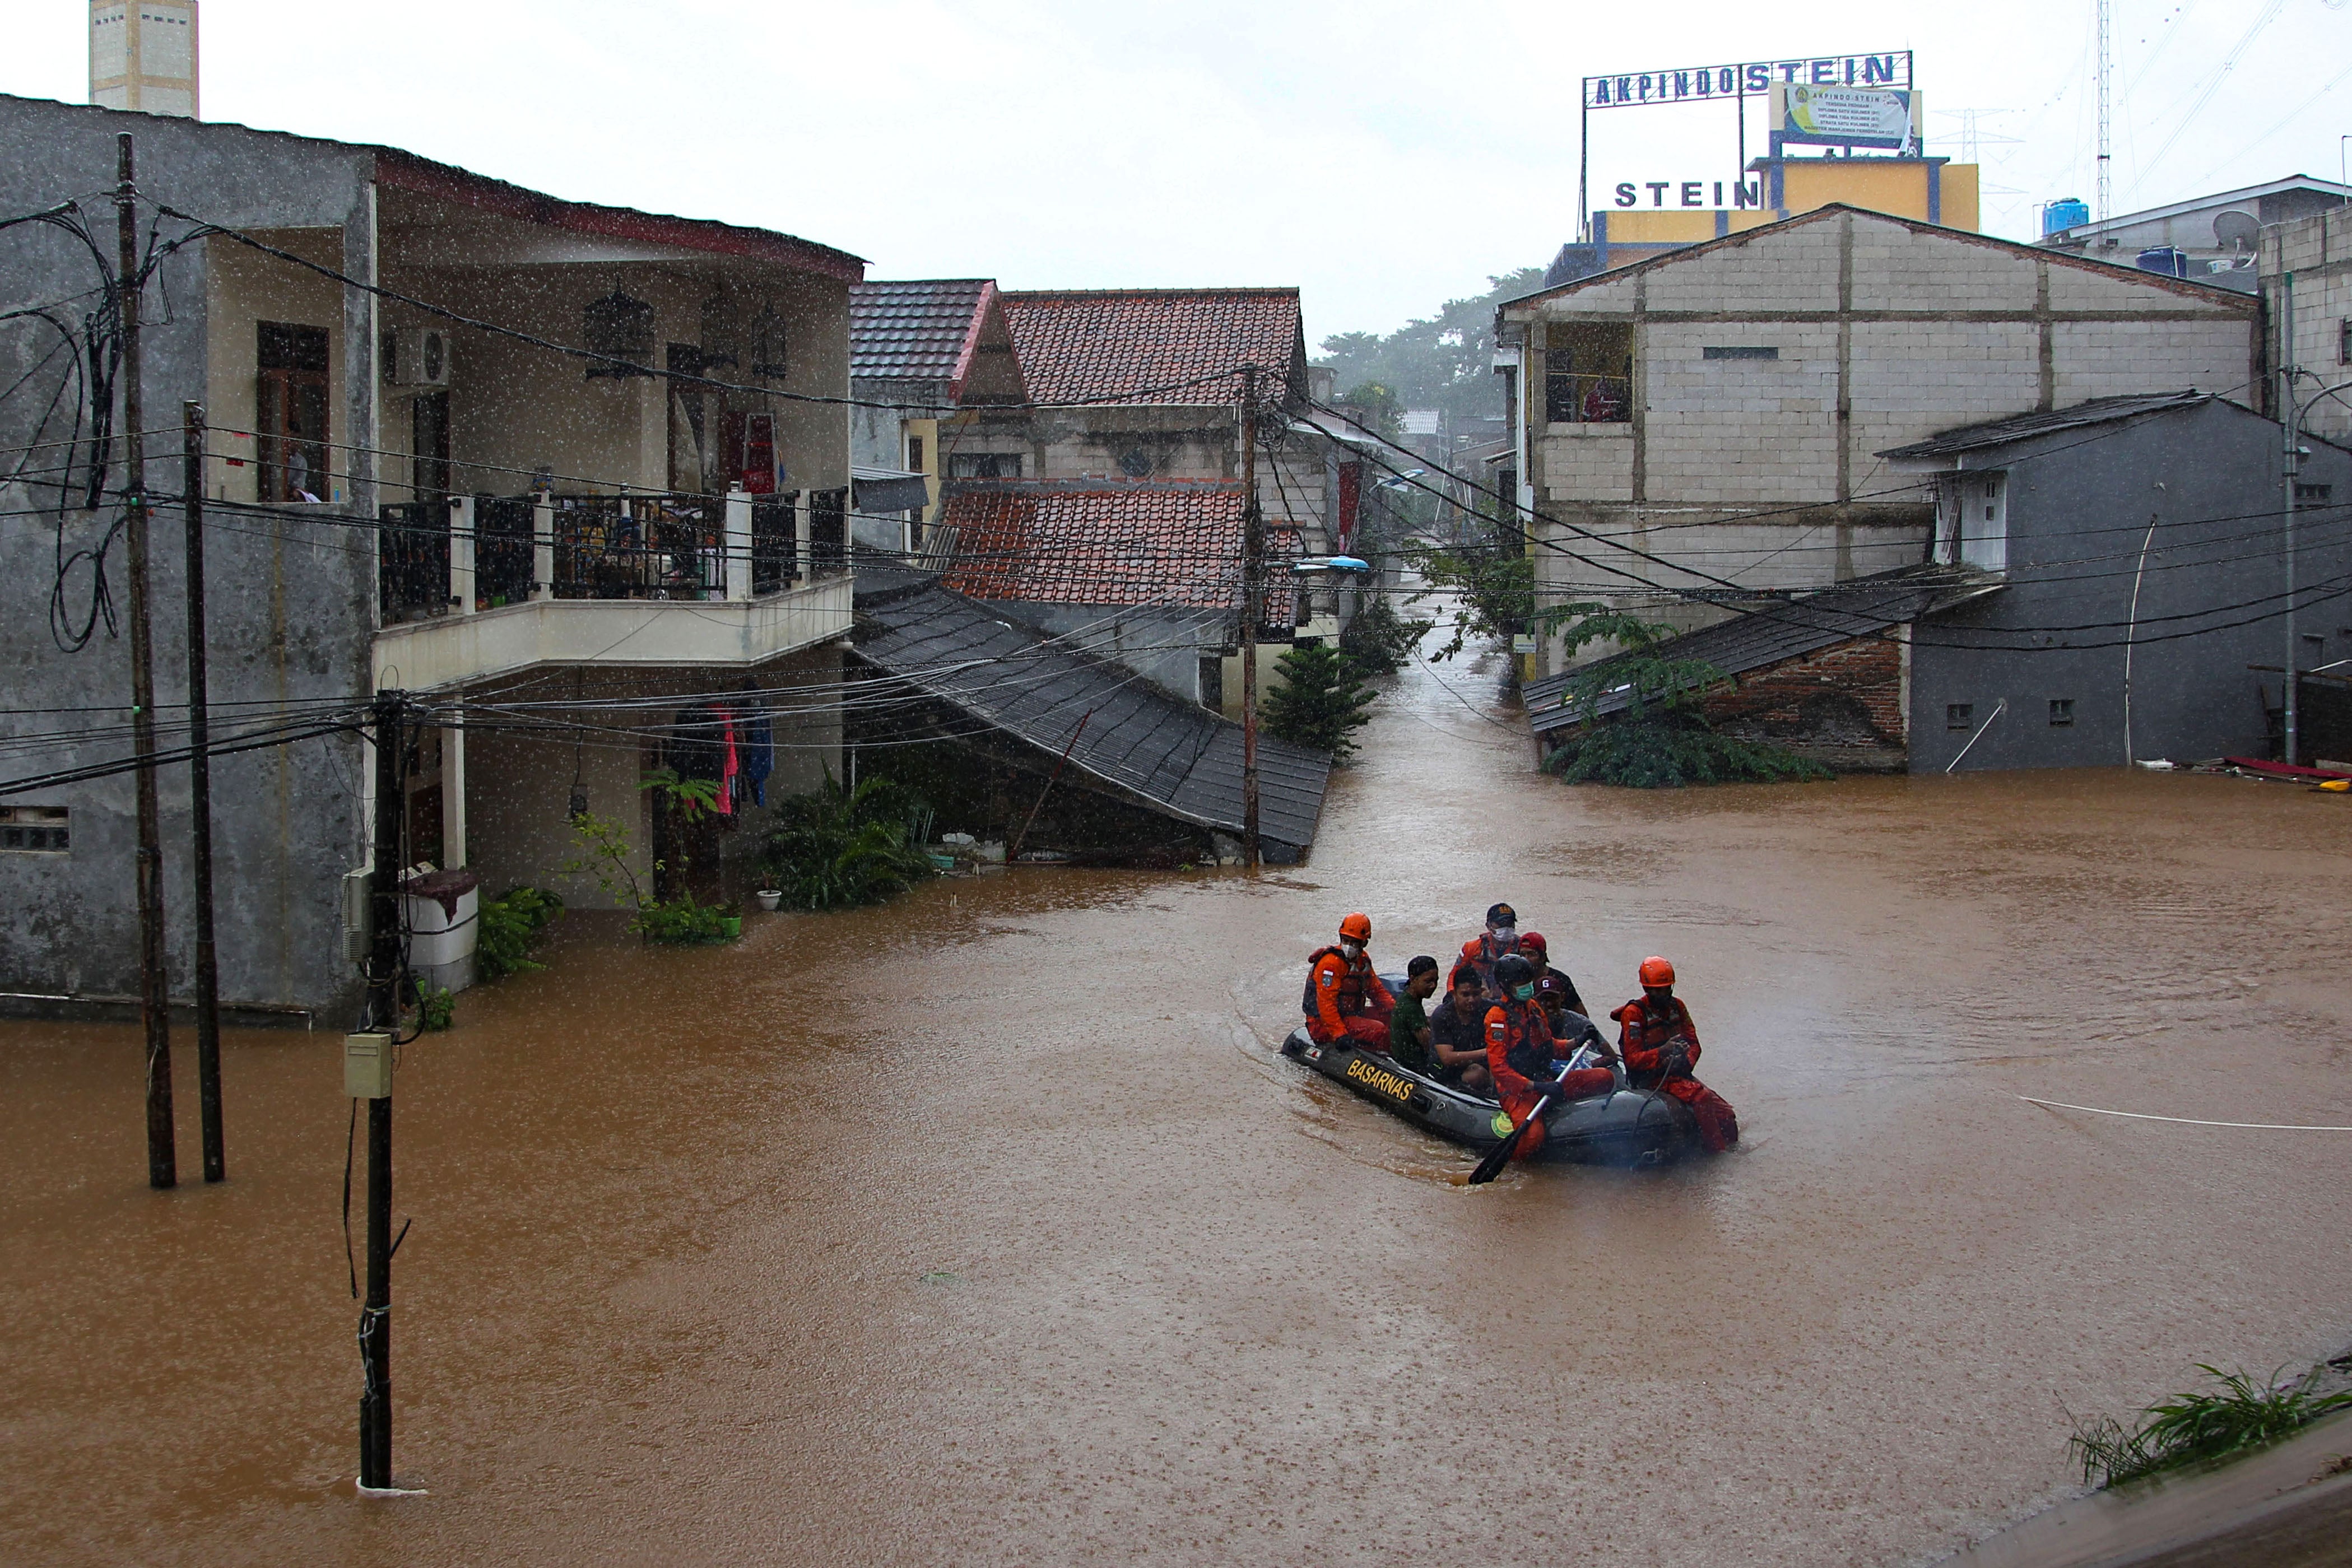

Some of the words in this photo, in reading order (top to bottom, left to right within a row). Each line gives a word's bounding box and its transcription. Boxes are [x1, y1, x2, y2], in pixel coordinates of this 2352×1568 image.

[1596, 68, 1733, 104] AKPINDO
[1746, 55, 1893, 91] STEIN
[1615, 182, 1758, 207] STEIN
[1347, 1059, 1414, 1101] BASARNAS
